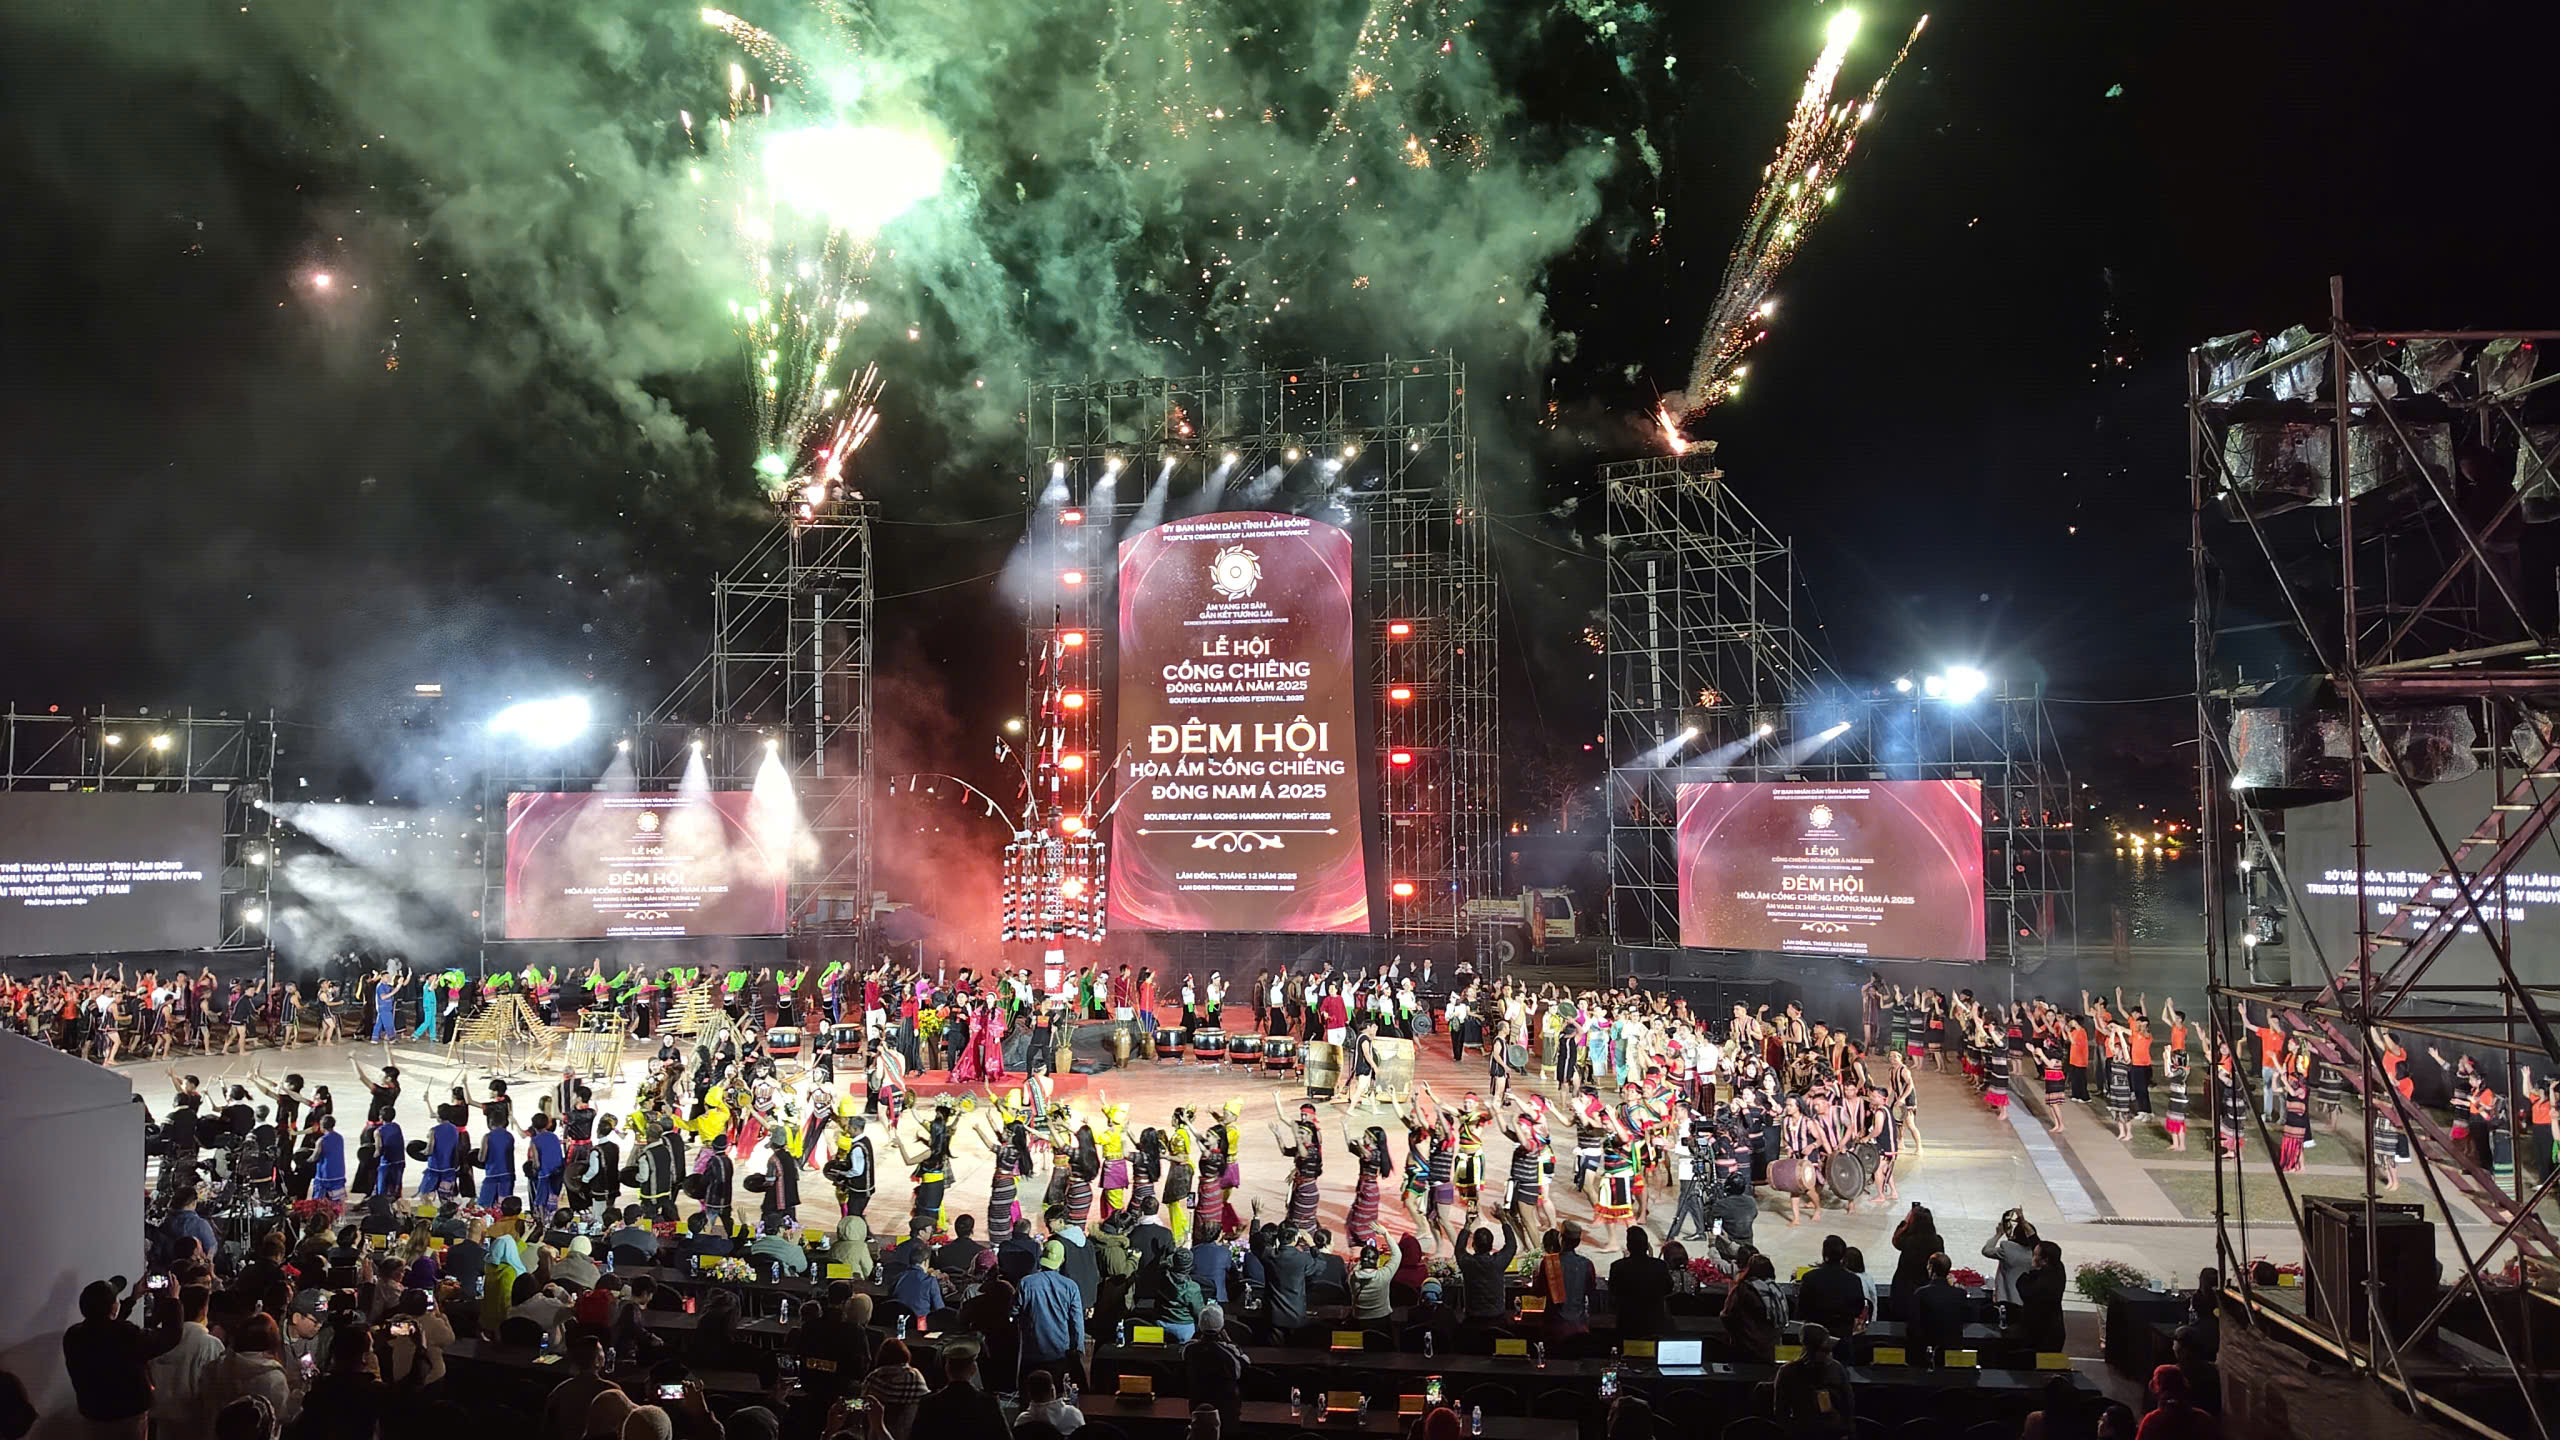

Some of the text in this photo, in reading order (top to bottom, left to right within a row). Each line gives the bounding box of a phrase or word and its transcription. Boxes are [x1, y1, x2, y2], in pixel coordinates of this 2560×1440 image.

[1176, 524, 1194, 532] BAN
[1233, 636, 1270, 658] HỘI
[1228, 659, 1310, 679] CHIÊNG
[1166, 681, 1202, 693] ĐÔNG
[1205, 682, 1232, 692] NAM
[1246, 680, 1275, 691] NĂM
[1276, 681, 1308, 690] 2025
[1148, 714, 1329, 759] ĐÊM HỘI
[1130, 760, 1172, 777] HÒA
[1269, 758, 1345, 775] CHIÊNG
[1152, 781, 1326, 799] ĐÔNG NAM Á 2025
[22, 863, 50, 872] THAO
[67, 863, 82, 871] DU
[71, 873, 105, 881] TRUNG
[608, 871, 648, 885] ĐÊM
[106, 884, 130, 894] NAM
[1782, 874, 1863, 895] ĐÊM HỘI
[2306, 884, 2338, 894] TRUNG
[2386, 887, 2407, 897] KHU
